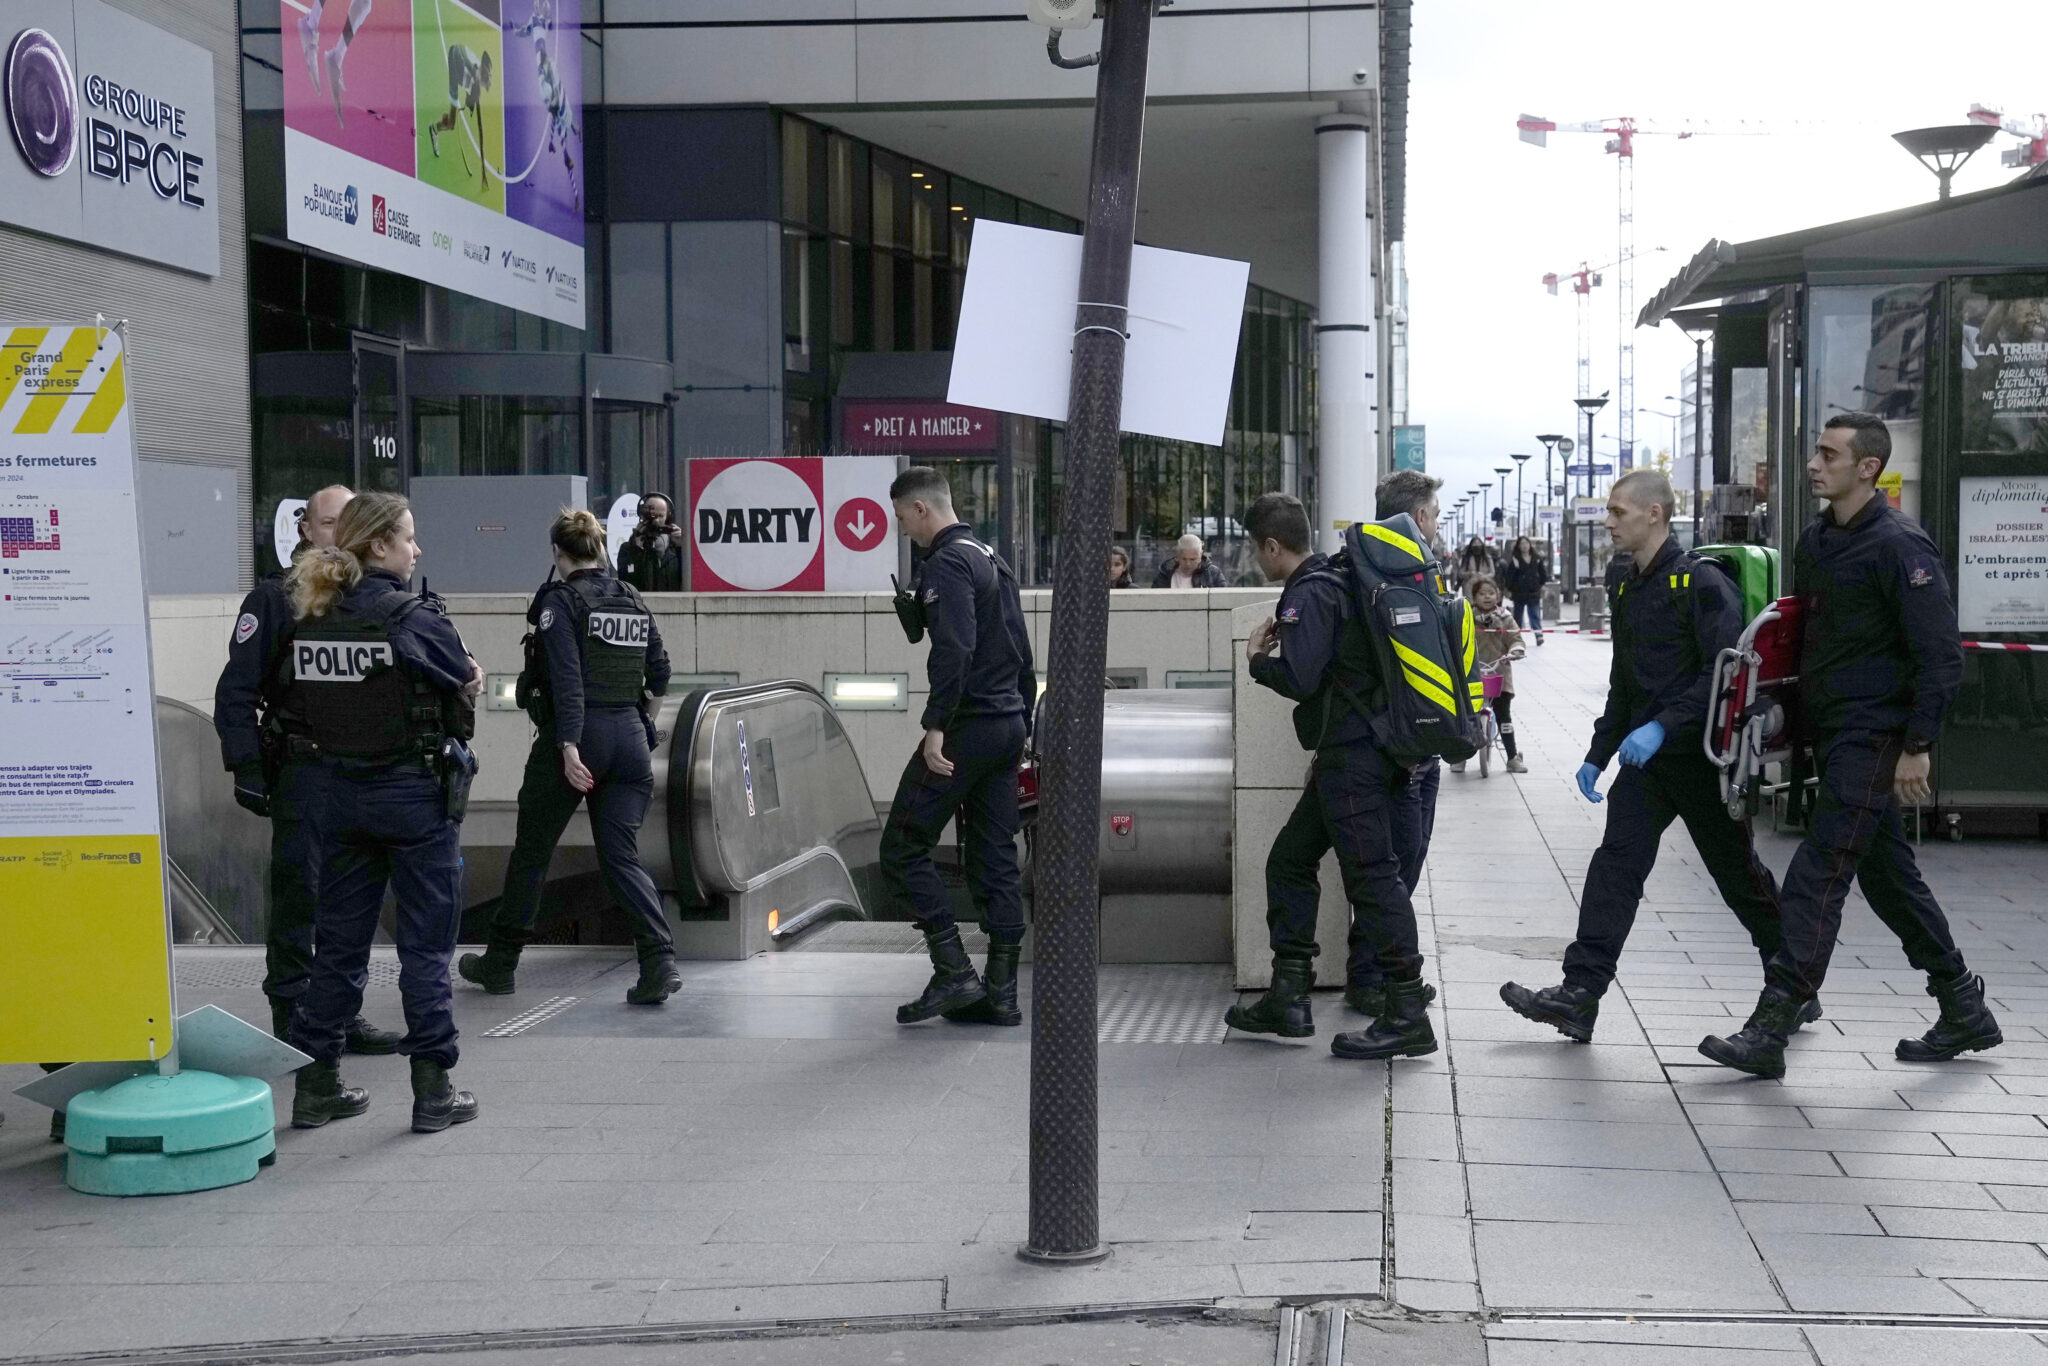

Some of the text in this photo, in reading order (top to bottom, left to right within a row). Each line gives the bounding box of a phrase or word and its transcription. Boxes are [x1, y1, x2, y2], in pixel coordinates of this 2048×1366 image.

[85, 74, 187, 138] GROUPE
[87, 116, 205, 208] BPCE
[313, 183, 343, 206] BANQUE
[304, 195, 343, 222] POPULAIRE
[387, 208, 409, 228] CAISSE
[388, 224, 421, 248] D'EPARGNE
[432, 231, 453, 256] oney
[512, 255, 537, 275] NATIXIS
[555, 271, 577, 289] NATIXIS
[1974, 343, 1999, 356] LA
[20, 351, 63, 363] Grand
[14, 364, 50, 376] Paris
[2029, 367, 2047, 377] QUE
[24, 378, 80, 390] express
[1982, 390, 1995, 400] NE
[1993, 400, 2004, 410] LE
[874, 416, 970, 436] PRET A MANGER
[373, 435, 397, 459] 110
[15, 455, 97, 467] fermetures
[2001, 481, 2039, 490] MONDE
[698, 507, 816, 543] DARTY
[1996, 522, 2044, 531] DOSSIER
[1964, 555, 2048, 564] L'embrasem
[1985, 569, 1999, 579] et
[2003, 569, 2040, 581] après
[589, 616, 649, 642] POLICE
[299, 645, 386, 677] POLICE
[21, 764, 26, 772] à
[28, 764, 54, 773] adapter
[69, 764, 92, 772] trajets
[22, 780, 31, 788] de
[33, 780, 83, 788] remplacement
[46, 788, 63, 797] Lyon
[73, 787, 116, 796] Olympiades.
[1113, 816, 1130, 824] STOP
